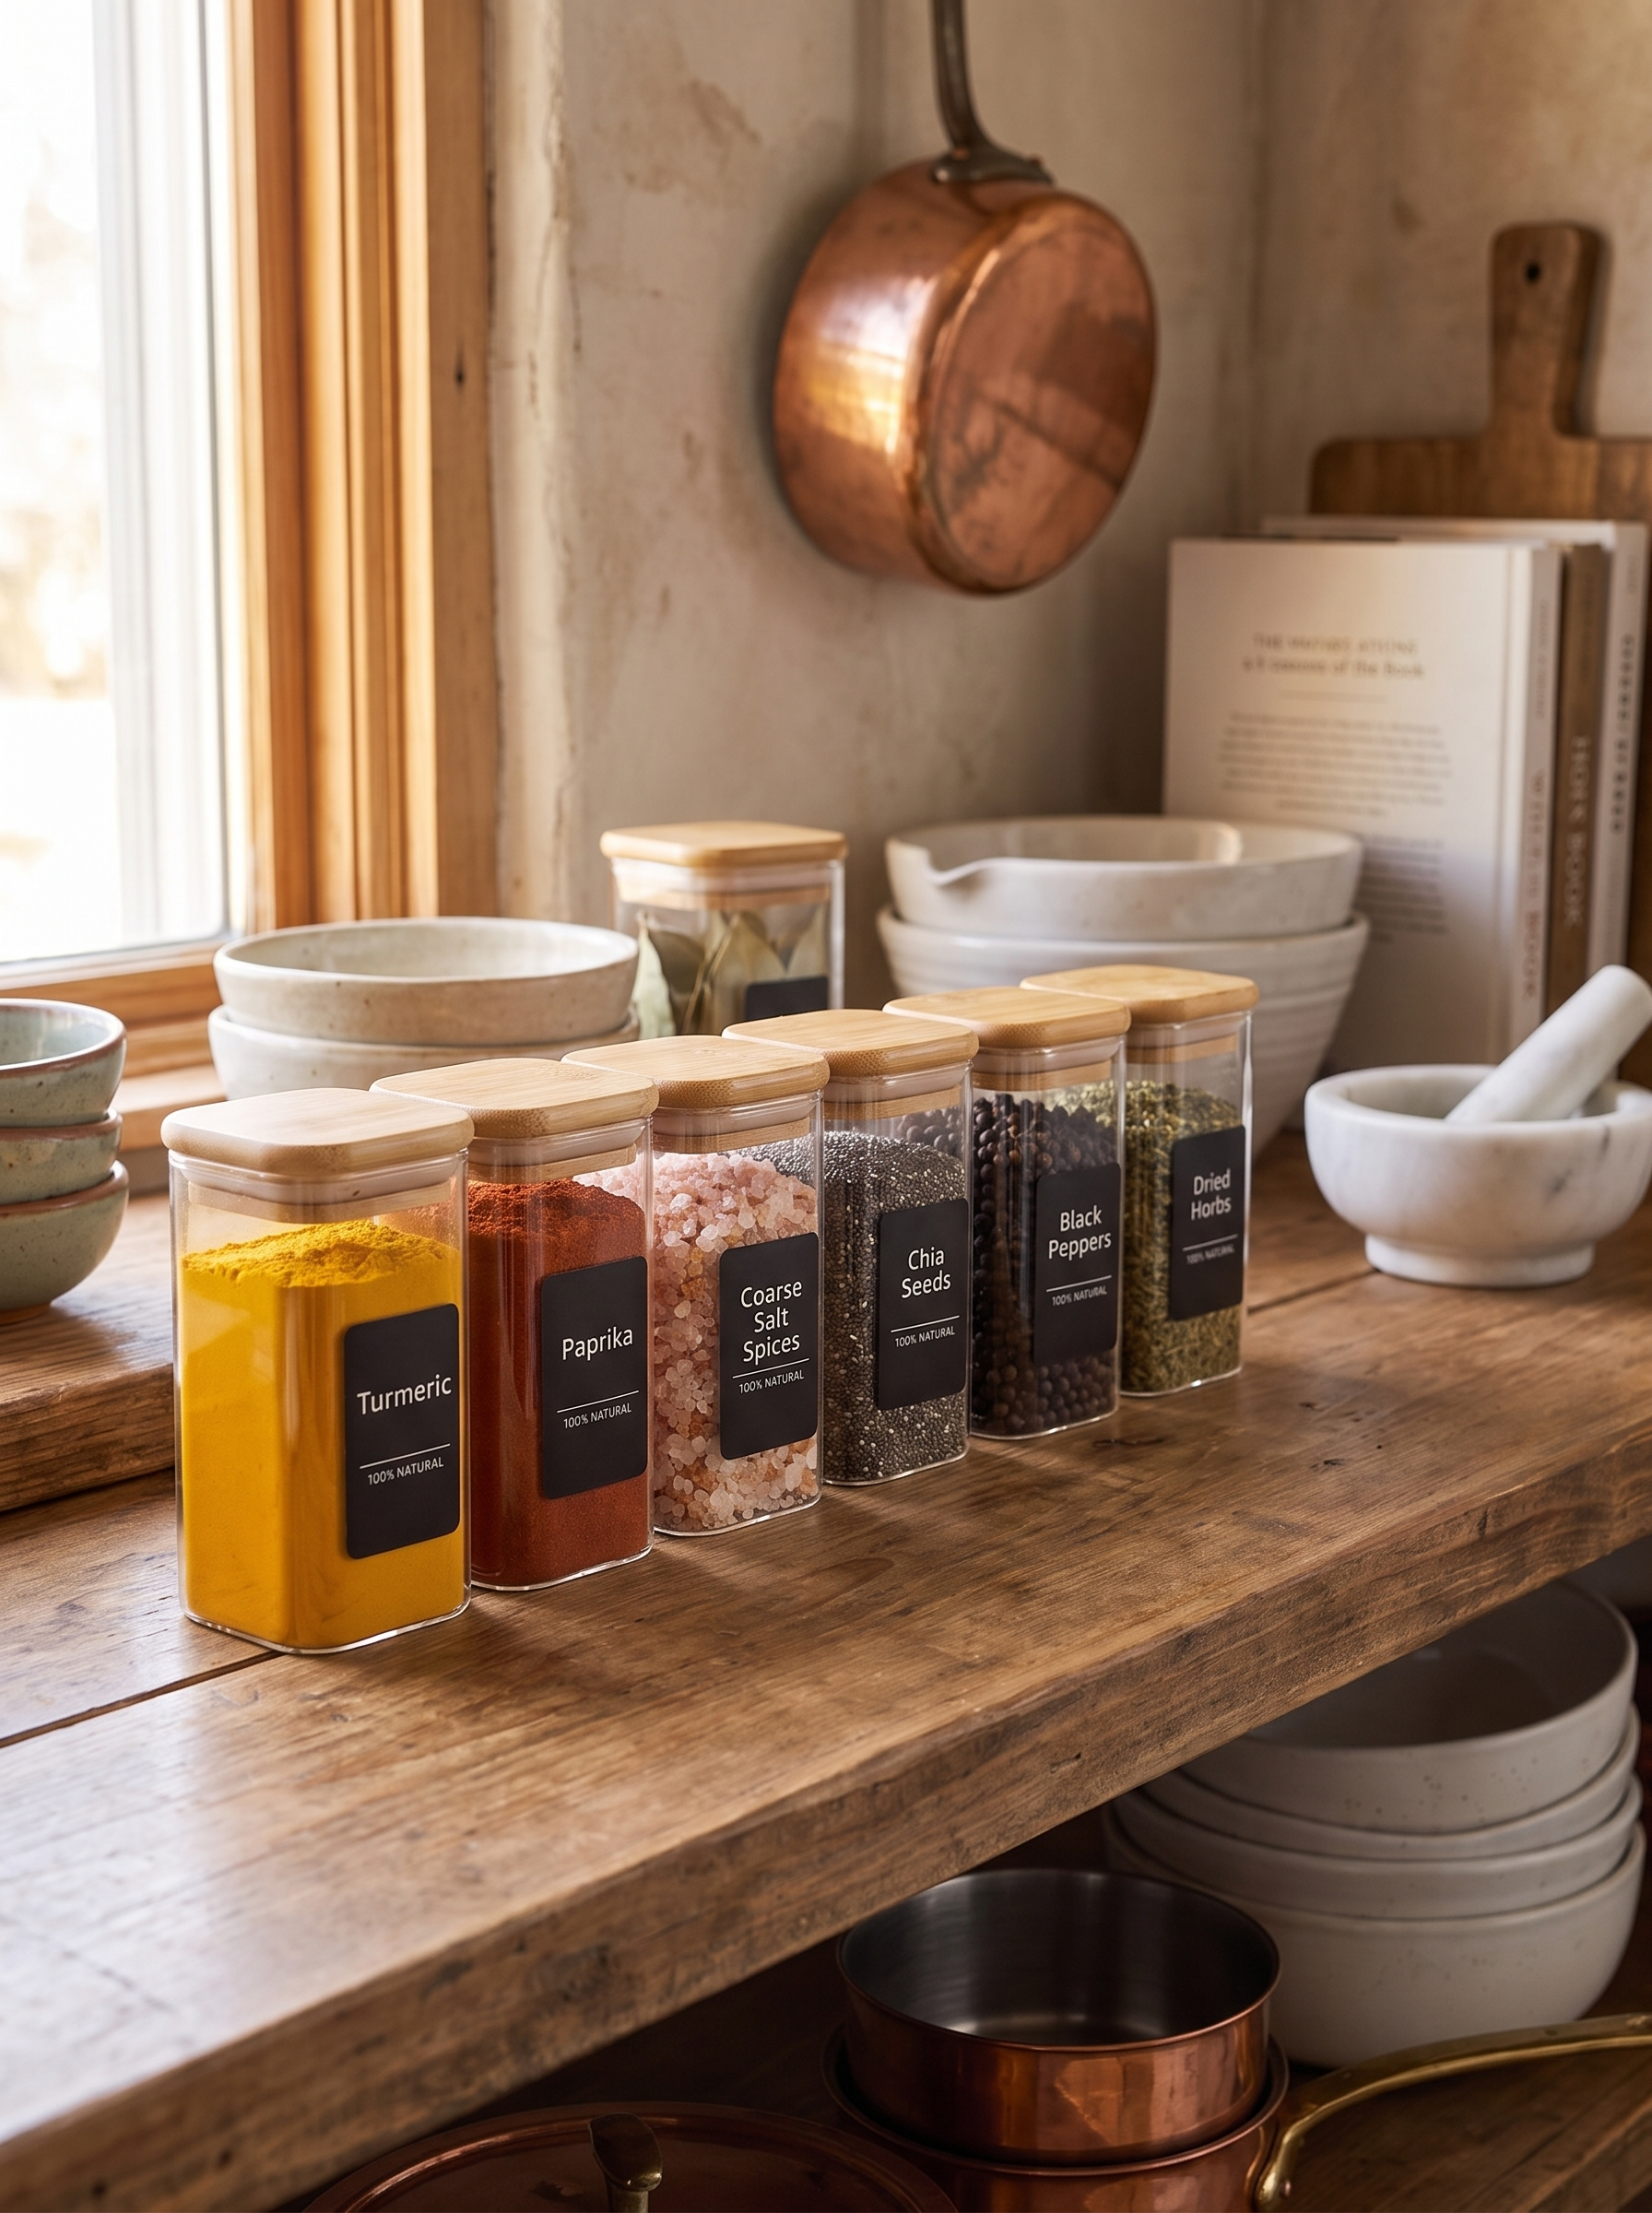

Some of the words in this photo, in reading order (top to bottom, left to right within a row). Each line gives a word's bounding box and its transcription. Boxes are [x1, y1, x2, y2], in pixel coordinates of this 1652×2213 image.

[1193, 1167, 1231, 1195] Dried
[1060, 1204, 1102, 1232] Black
[908, 1247, 944, 1271] Chia
[1048, 1233, 1112, 1261] Peppers
[740, 1281, 802, 1308] Coarse
[902, 1270, 951, 1298] Seeds
[1052, 1293, 1072, 1306] 100%
[1073, 1285, 1107, 1302] NATURAL
[754, 1307, 789, 1333] Salt
[562, 1326, 633, 1361] Paprika
[743, 1335, 800, 1366] Spices
[895, 1334, 917, 1347] 100%
[918, 1326, 955, 1343] NATURAL
[357, 1374, 452, 1414] Turmeric
[738, 1379, 762, 1393] 100%
[764, 1369, 804, 1388] NATURAL
[563, 1414, 588, 1428] 100%
[590, 1402, 631, 1422] NATURAL
[368, 1469, 395, 1485] 100%
[396, 1457, 443, 1477] NATURAL
